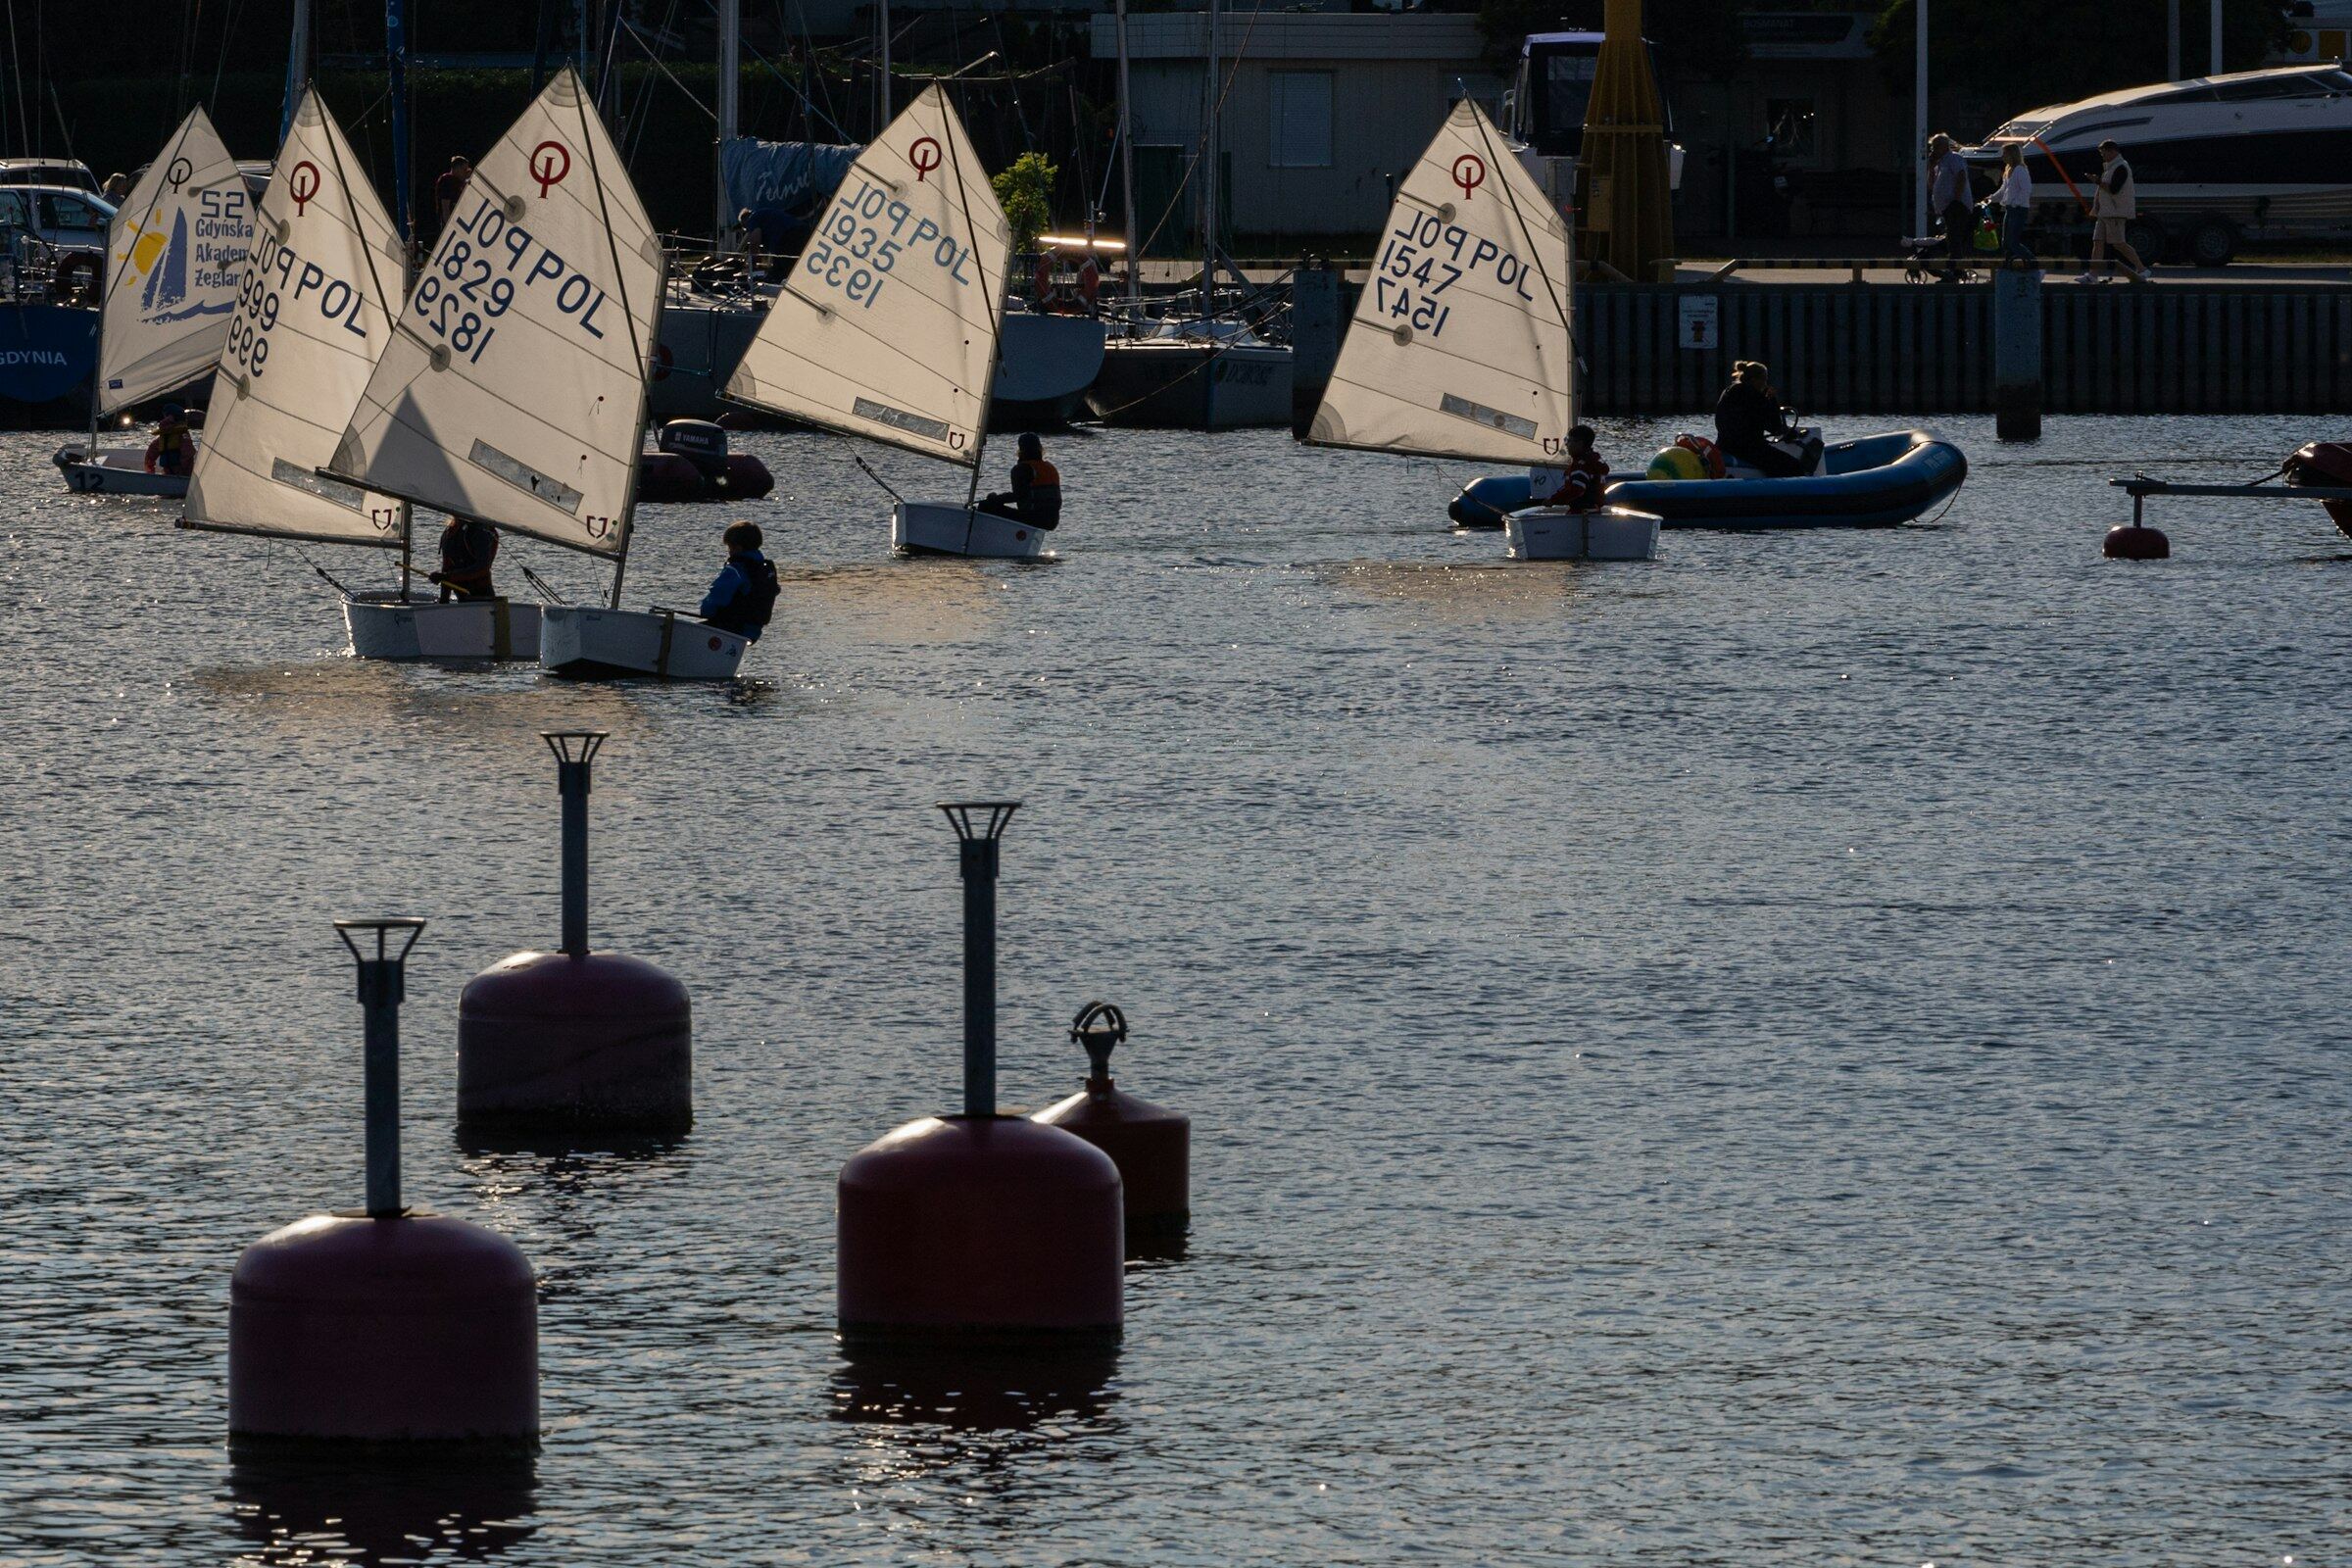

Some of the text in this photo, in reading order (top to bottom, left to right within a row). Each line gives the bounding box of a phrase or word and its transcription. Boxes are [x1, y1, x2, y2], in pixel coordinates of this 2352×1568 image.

[196, 219, 253, 239] Gdyńska
[821, 208, 904, 272] 1935
[907, 218, 969, 286] POL
[434, 229, 514, 318] 1829
[524, 249, 606, 340] POL
[1380, 239, 1463, 295] 1547
[1469, 238, 1533, 302] POL
[239, 269, 279, 331] 999
[294, 261, 367, 338] POL
[682, 433, 710, 445] YAMAHA
[75, 471, 104, 490] 12
